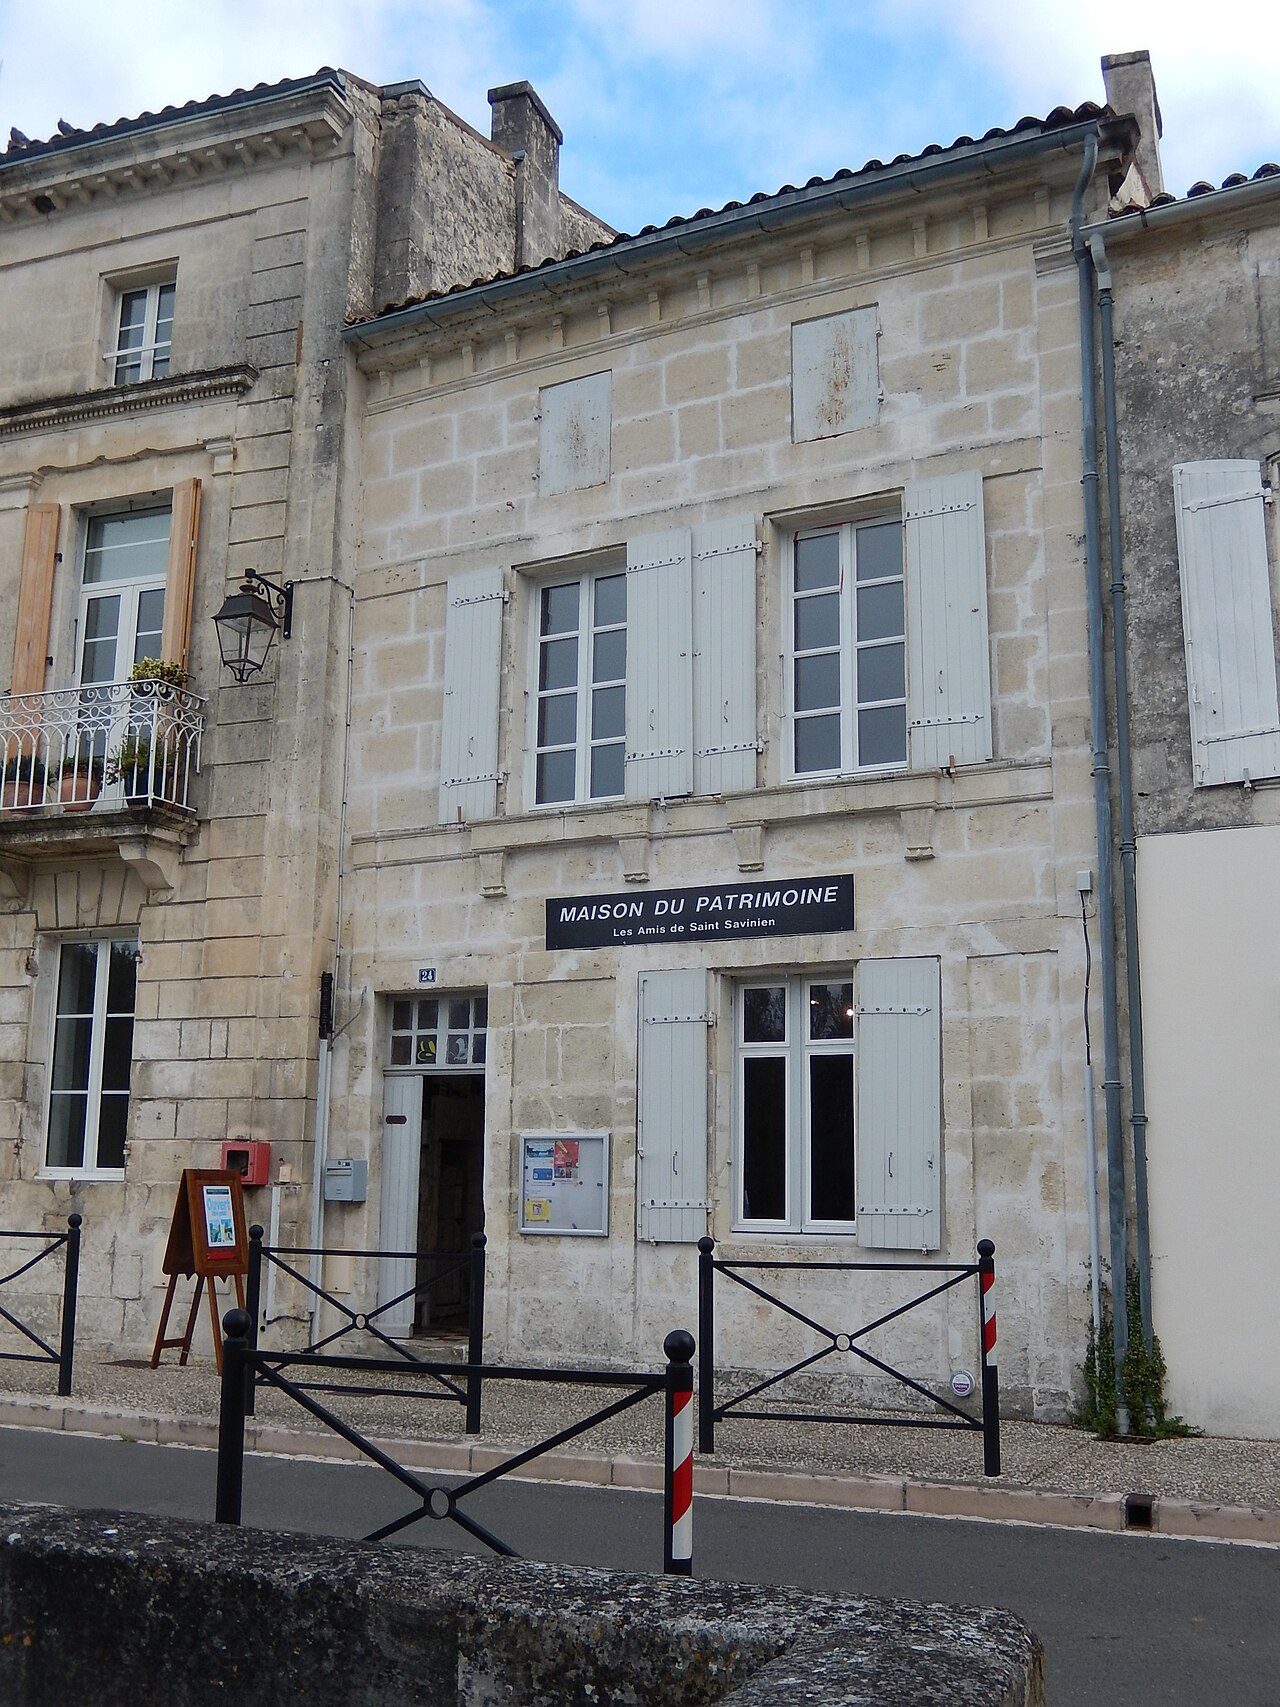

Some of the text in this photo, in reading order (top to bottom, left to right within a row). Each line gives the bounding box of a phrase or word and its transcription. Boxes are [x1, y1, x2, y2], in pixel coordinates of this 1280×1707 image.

[559, 885, 839, 922] MAISON DU PATRIMOINE
[613, 918, 776, 937] Les Amis de Saint Savinien
[421, 970, 433, 981] 24
[207, 1198, 230, 1210] Ouvert
